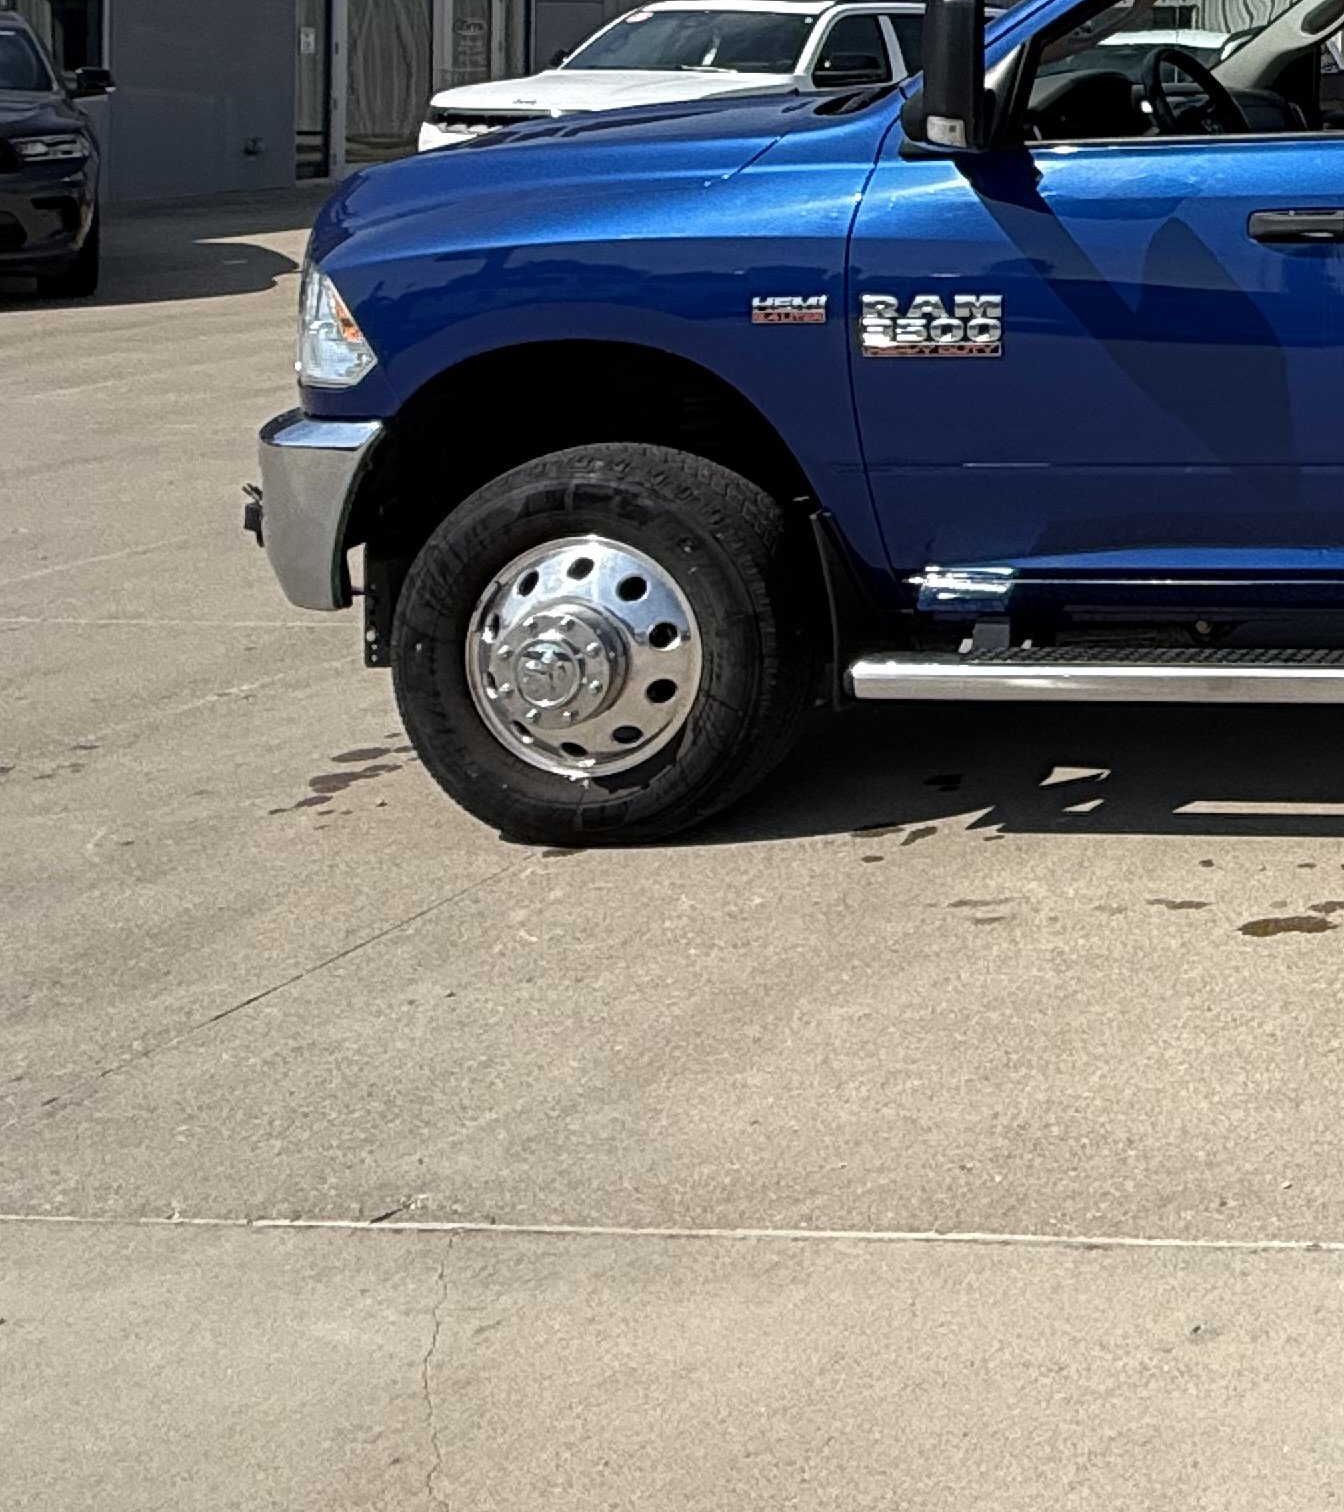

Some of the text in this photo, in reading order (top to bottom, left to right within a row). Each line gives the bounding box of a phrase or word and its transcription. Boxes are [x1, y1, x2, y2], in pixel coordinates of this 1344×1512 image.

[752, 295, 827, 310] HEMI
[862, 295, 1002, 317] RAM
[862, 317, 1002, 343] 3500
